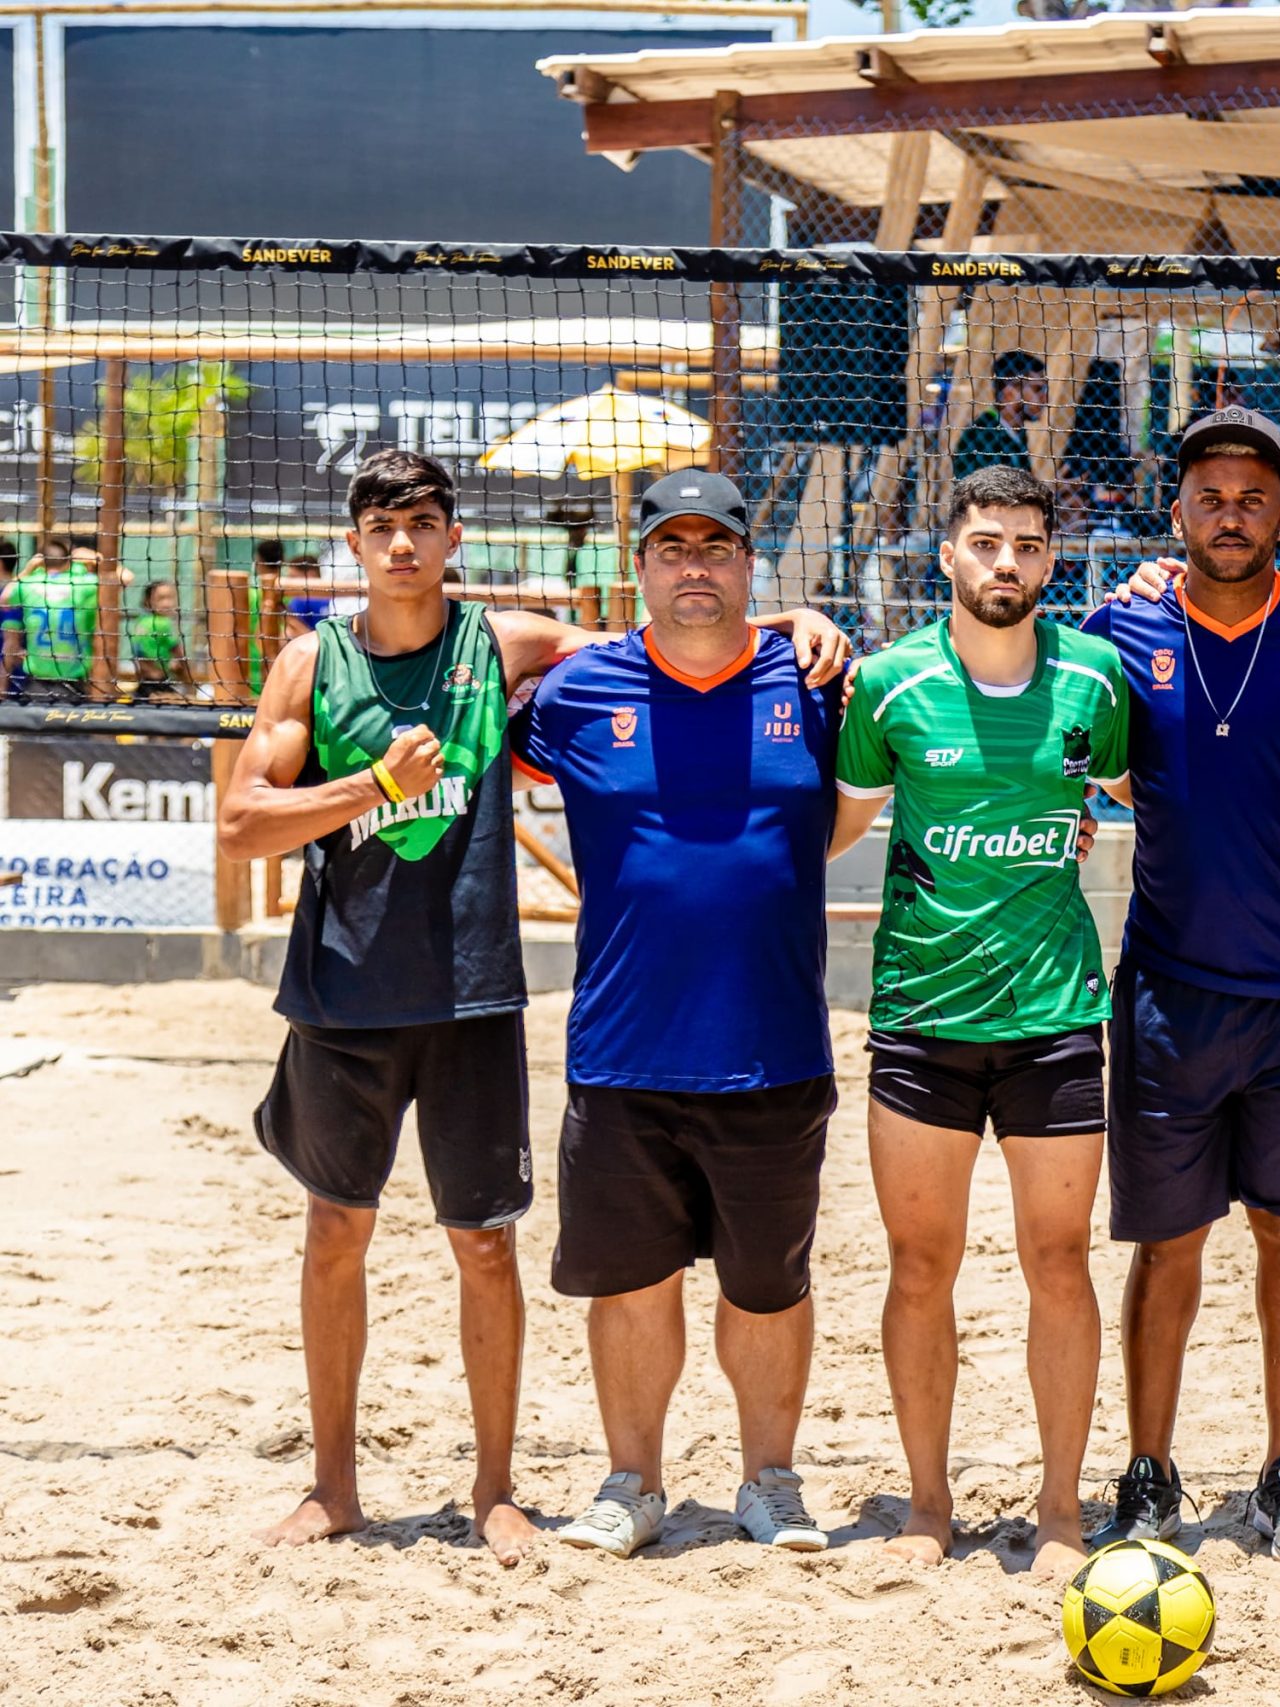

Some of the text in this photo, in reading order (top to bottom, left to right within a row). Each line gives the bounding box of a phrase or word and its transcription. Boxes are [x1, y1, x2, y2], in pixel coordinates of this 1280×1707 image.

[242, 248, 332, 263] SANDEVER
[587, 255, 674, 270] SANDEVER
[931, 262, 1021, 277] SANDEVER
[389, 401, 554, 456] TELE
[219, 713, 256, 728] SAN
[764, 722, 800, 736] JUBS
[924, 748, 964, 762] STY
[923, 825, 1059, 862] Cifrabet
[0, 853, 169, 885] DERAÇÃO
[0, 885, 87, 907] EIRA
